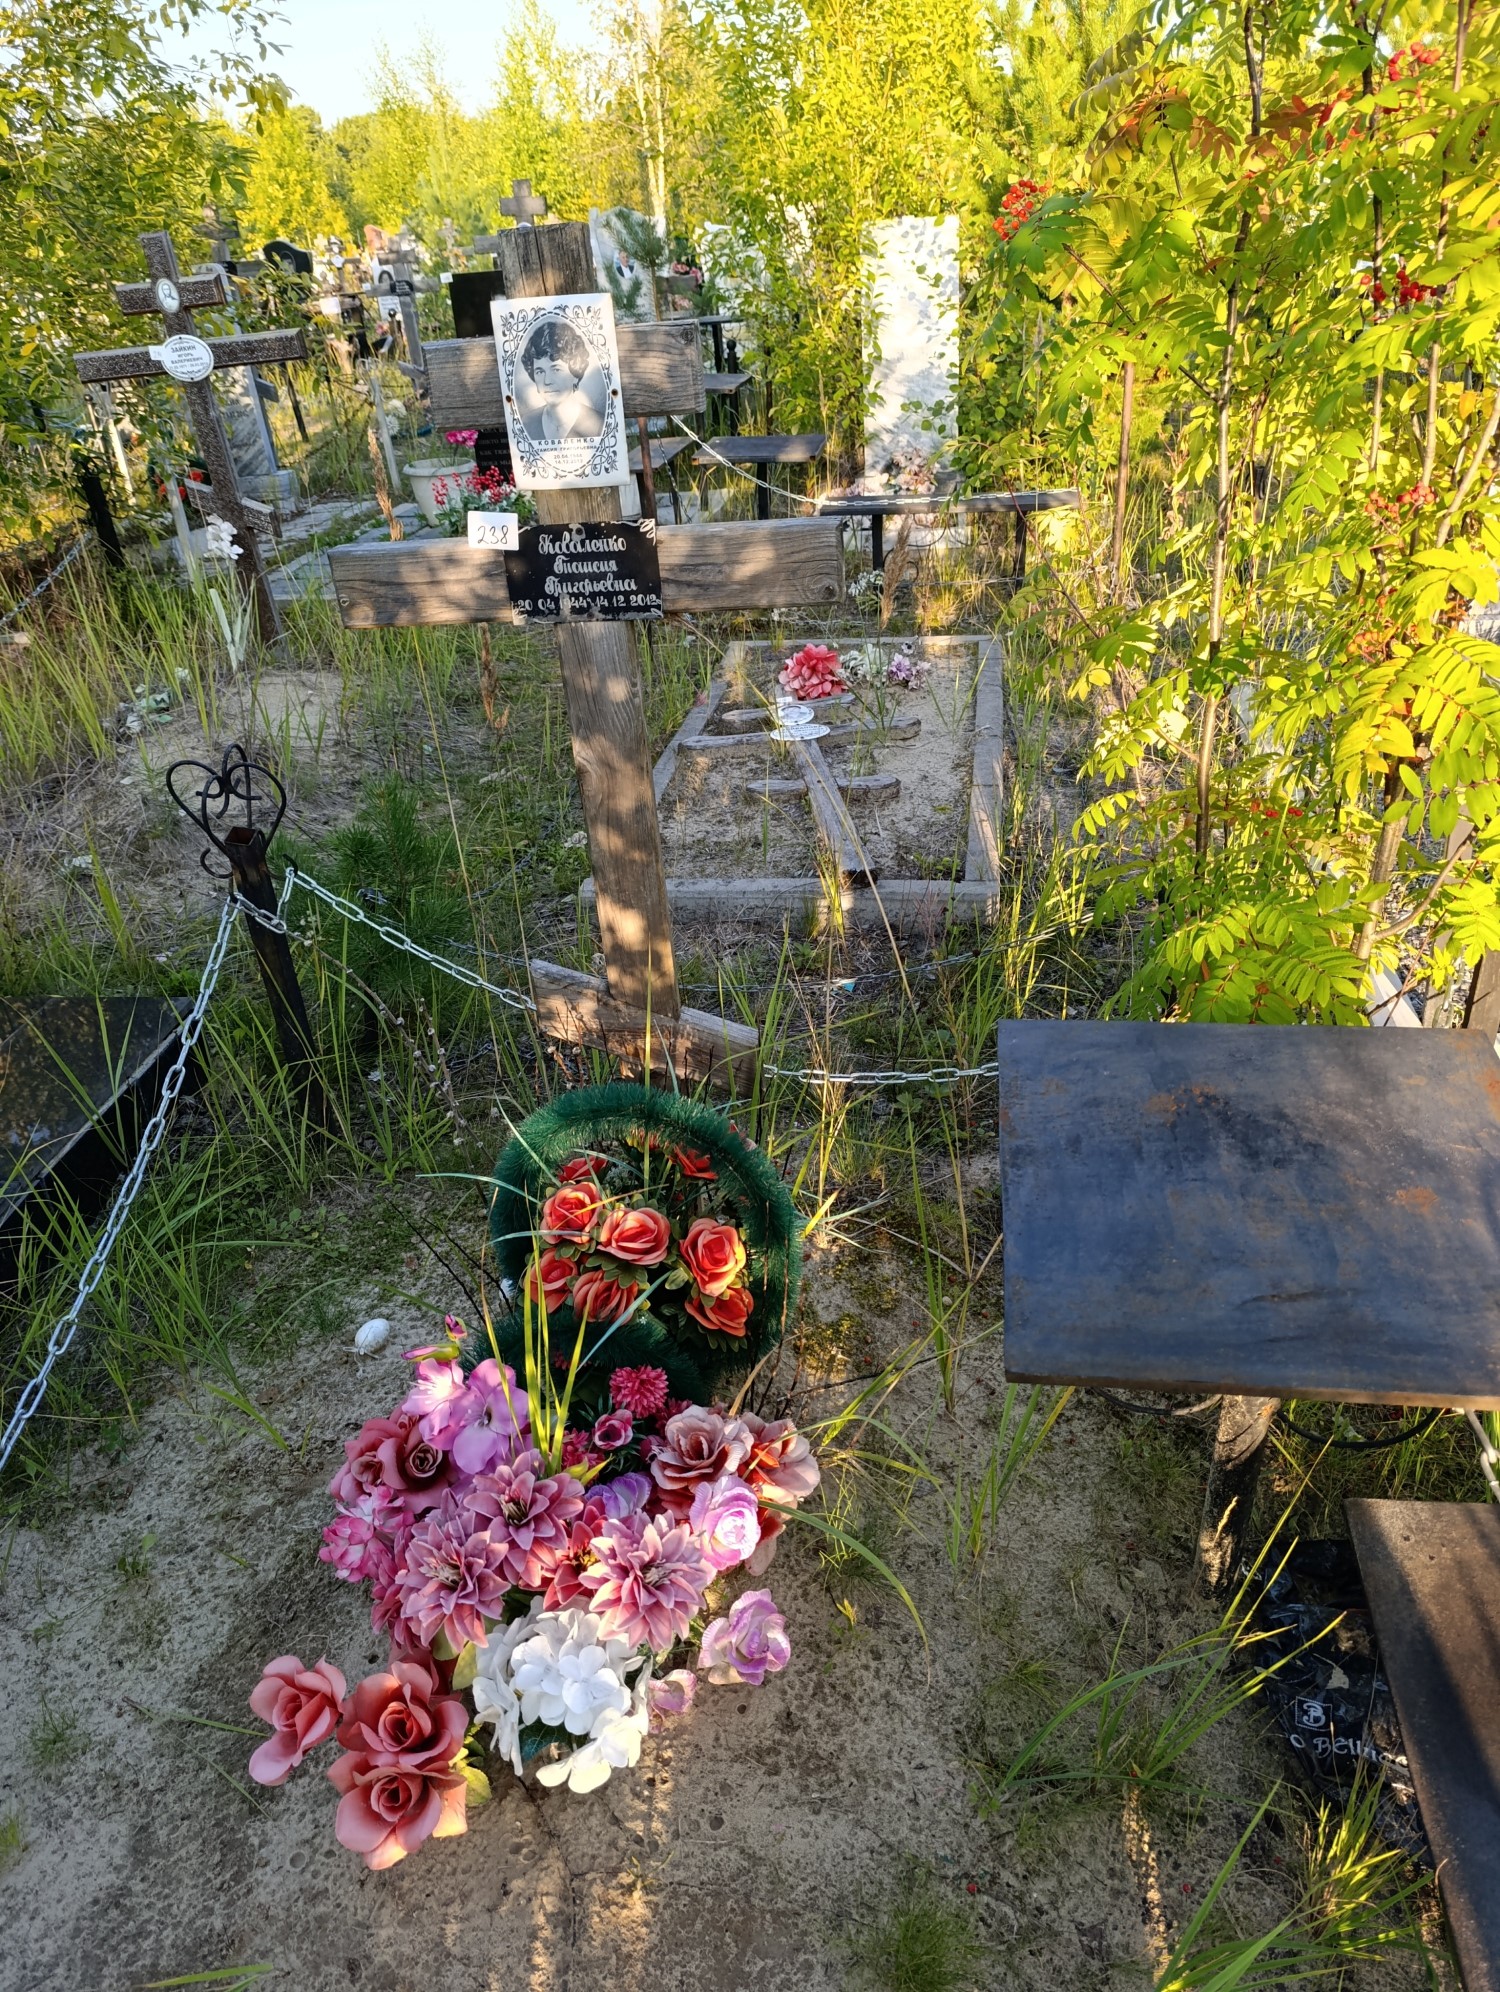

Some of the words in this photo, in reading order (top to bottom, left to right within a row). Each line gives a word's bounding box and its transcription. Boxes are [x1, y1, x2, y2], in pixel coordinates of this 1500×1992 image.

[171, 345, 196, 353] ЗАЙКИН
[538, 438, 595, 446] КОВАЛЕНКО
[477, 524, 509, 545] 238
[538, 531, 627, 555] Коваленко
[553, 555, 618, 574] Таисия
[517, 599, 533, 611] 20
[538, 599, 555, 611] 04
[612, 595, 626, 606] 12
[630, 594, 658, 606] 2012
